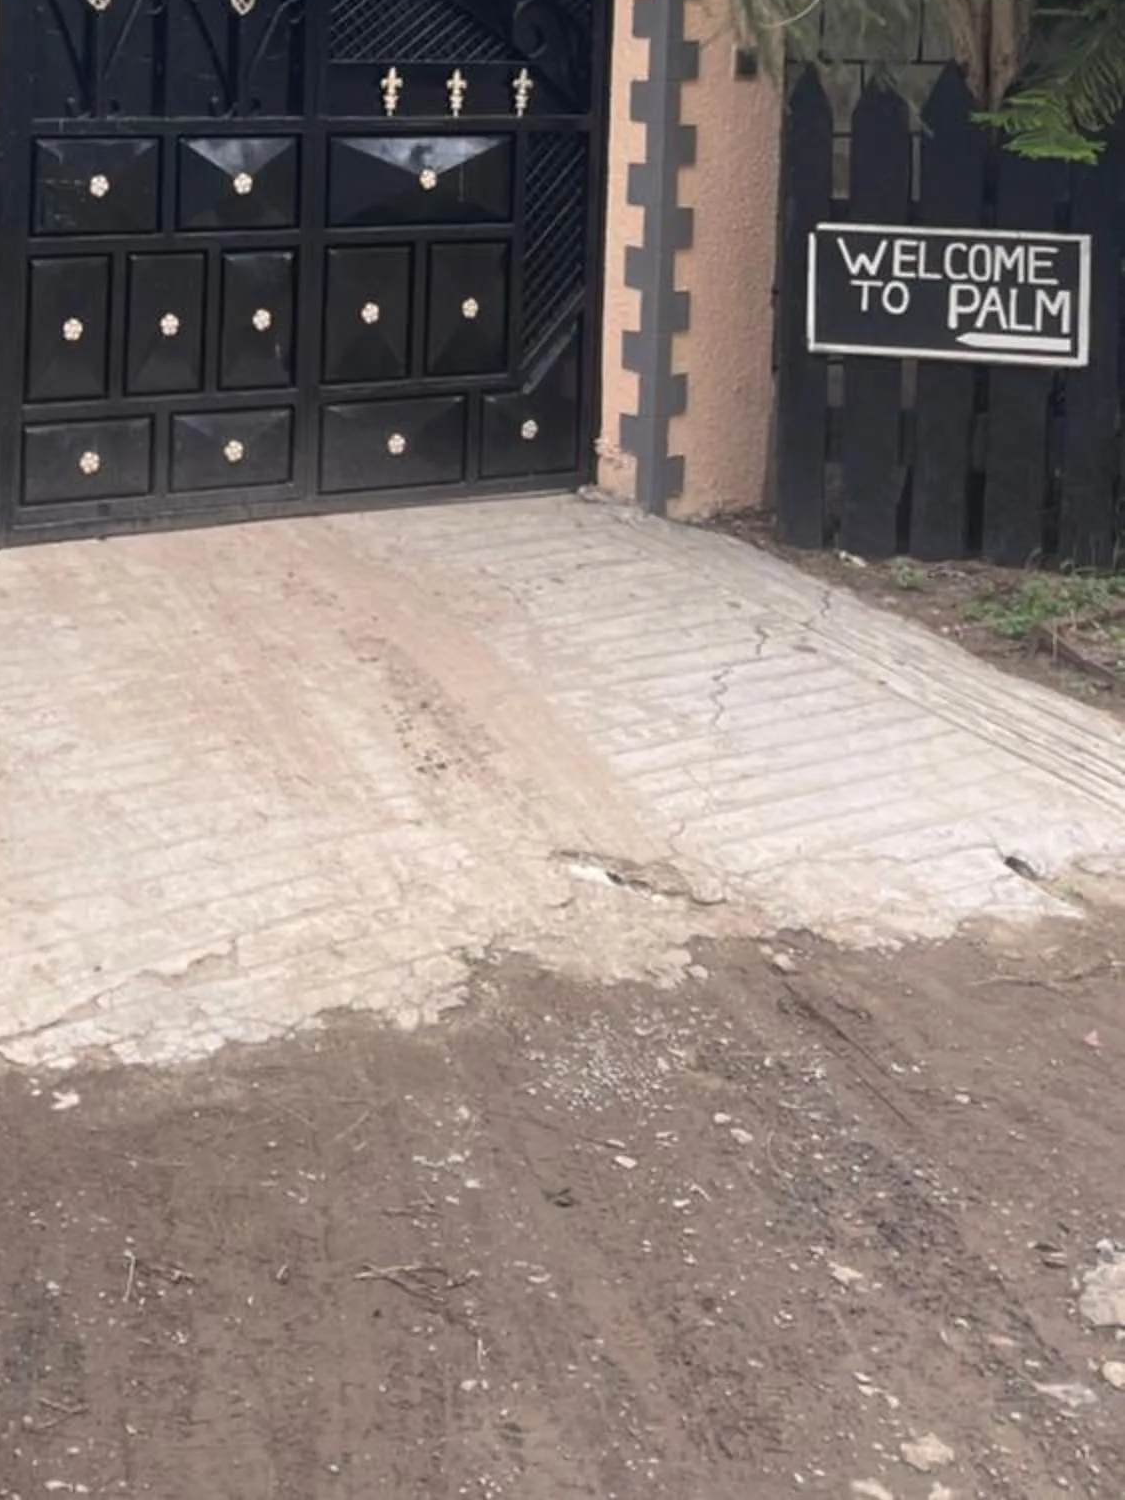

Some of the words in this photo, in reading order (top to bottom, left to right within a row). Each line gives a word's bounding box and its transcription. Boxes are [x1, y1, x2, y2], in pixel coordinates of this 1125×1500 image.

[836, 236, 1059, 285] WELCOME
[849, 279, 911, 315] TO
[947, 282, 1072, 334] PALM
